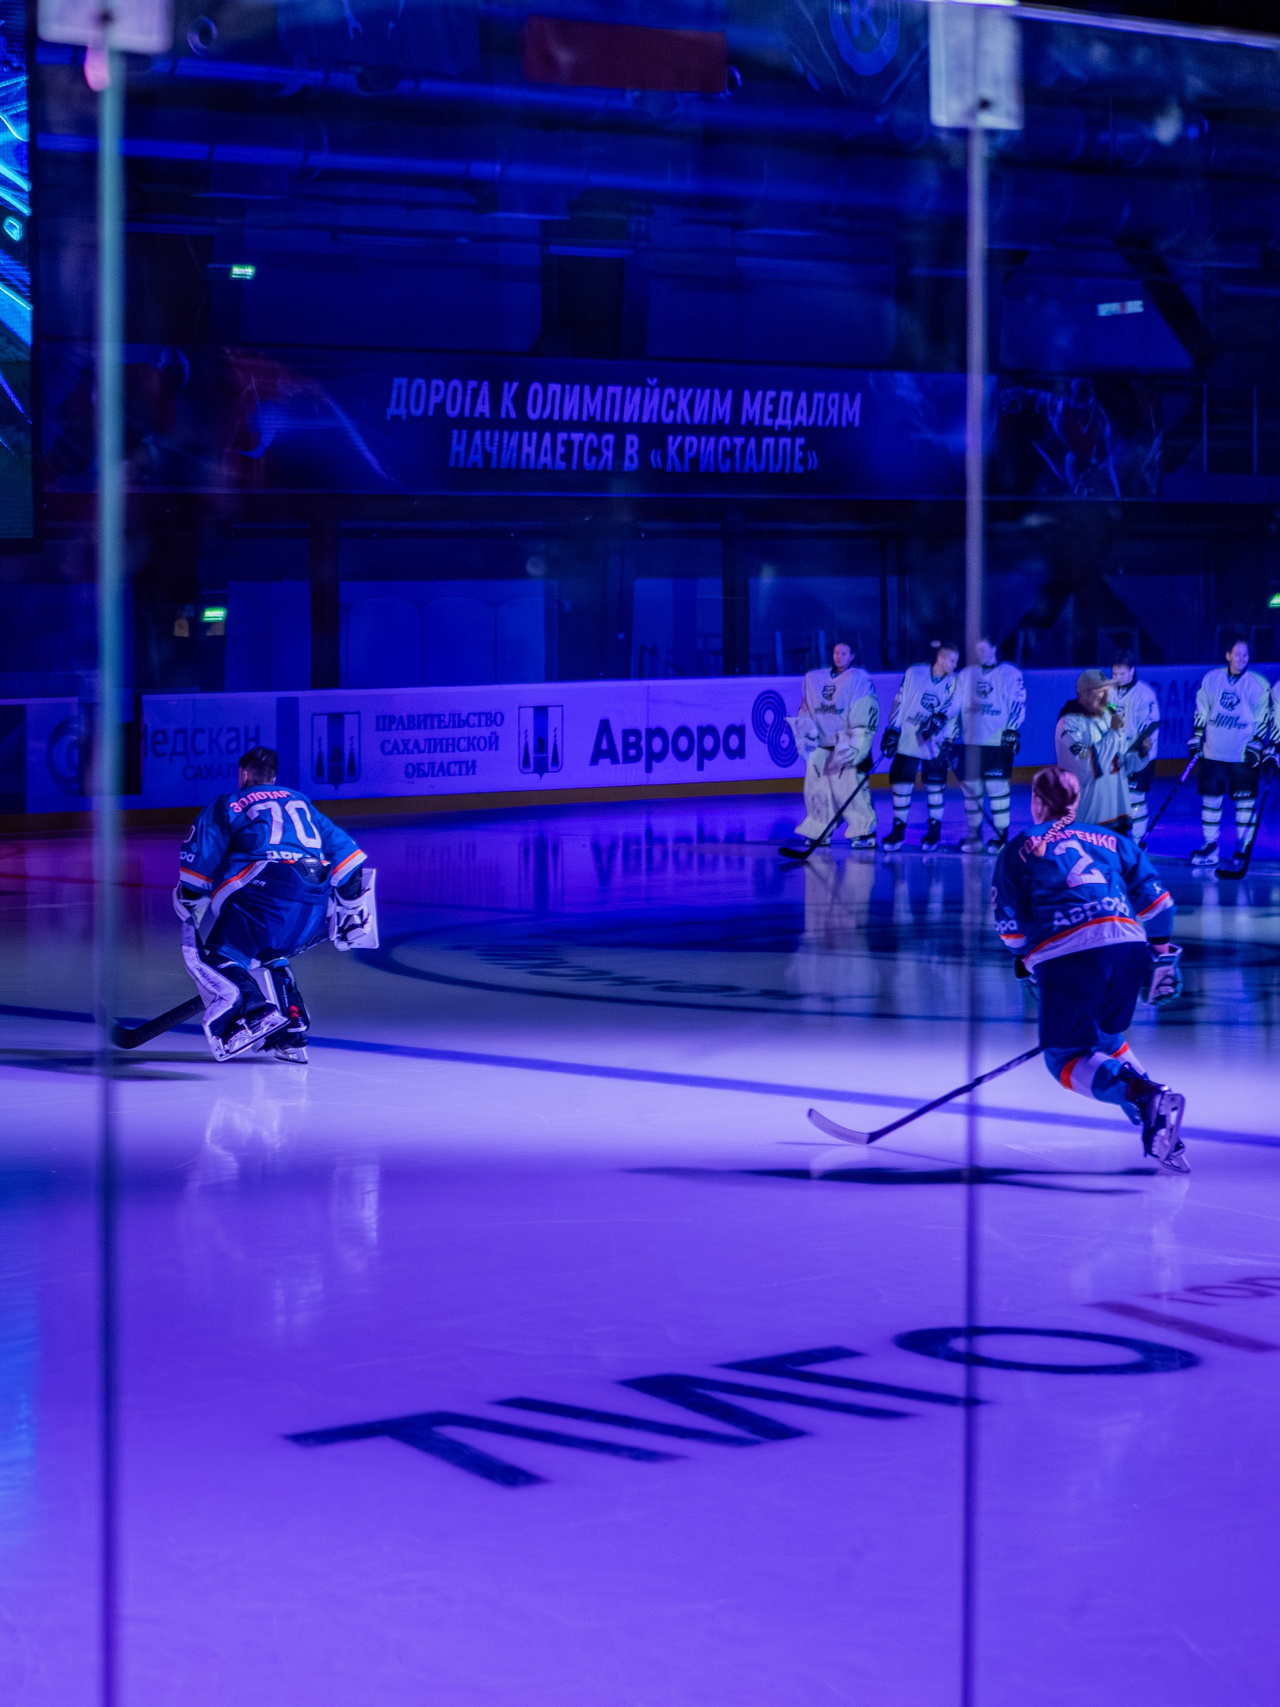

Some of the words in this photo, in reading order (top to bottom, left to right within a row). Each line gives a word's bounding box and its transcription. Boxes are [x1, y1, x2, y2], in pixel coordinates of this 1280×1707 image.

[386, 377, 491, 421] ДОРОГА
[500, 381, 519, 419] К
[526, 377, 733, 425] ОЛИМПИЙСКИМ
[740, 389, 862, 431] МЕДАЛЯМ
[448, 429, 615, 471] НАЧИНАЕТСЯ
[623, 433, 639, 472] В
[650, 434, 819, 474] «КРИСТАЛЛЕ»
[374, 711, 505, 732] ПРАВИТЕЛЬСТВО
[380, 731, 500, 756] САХАЛИНСКОЙ
[404, 759, 477, 779] ОБЛАСТИ
[589, 718, 746, 774] Аврора
[246, 799, 323, 849] 70
[1053, 840, 1108, 888] 2
